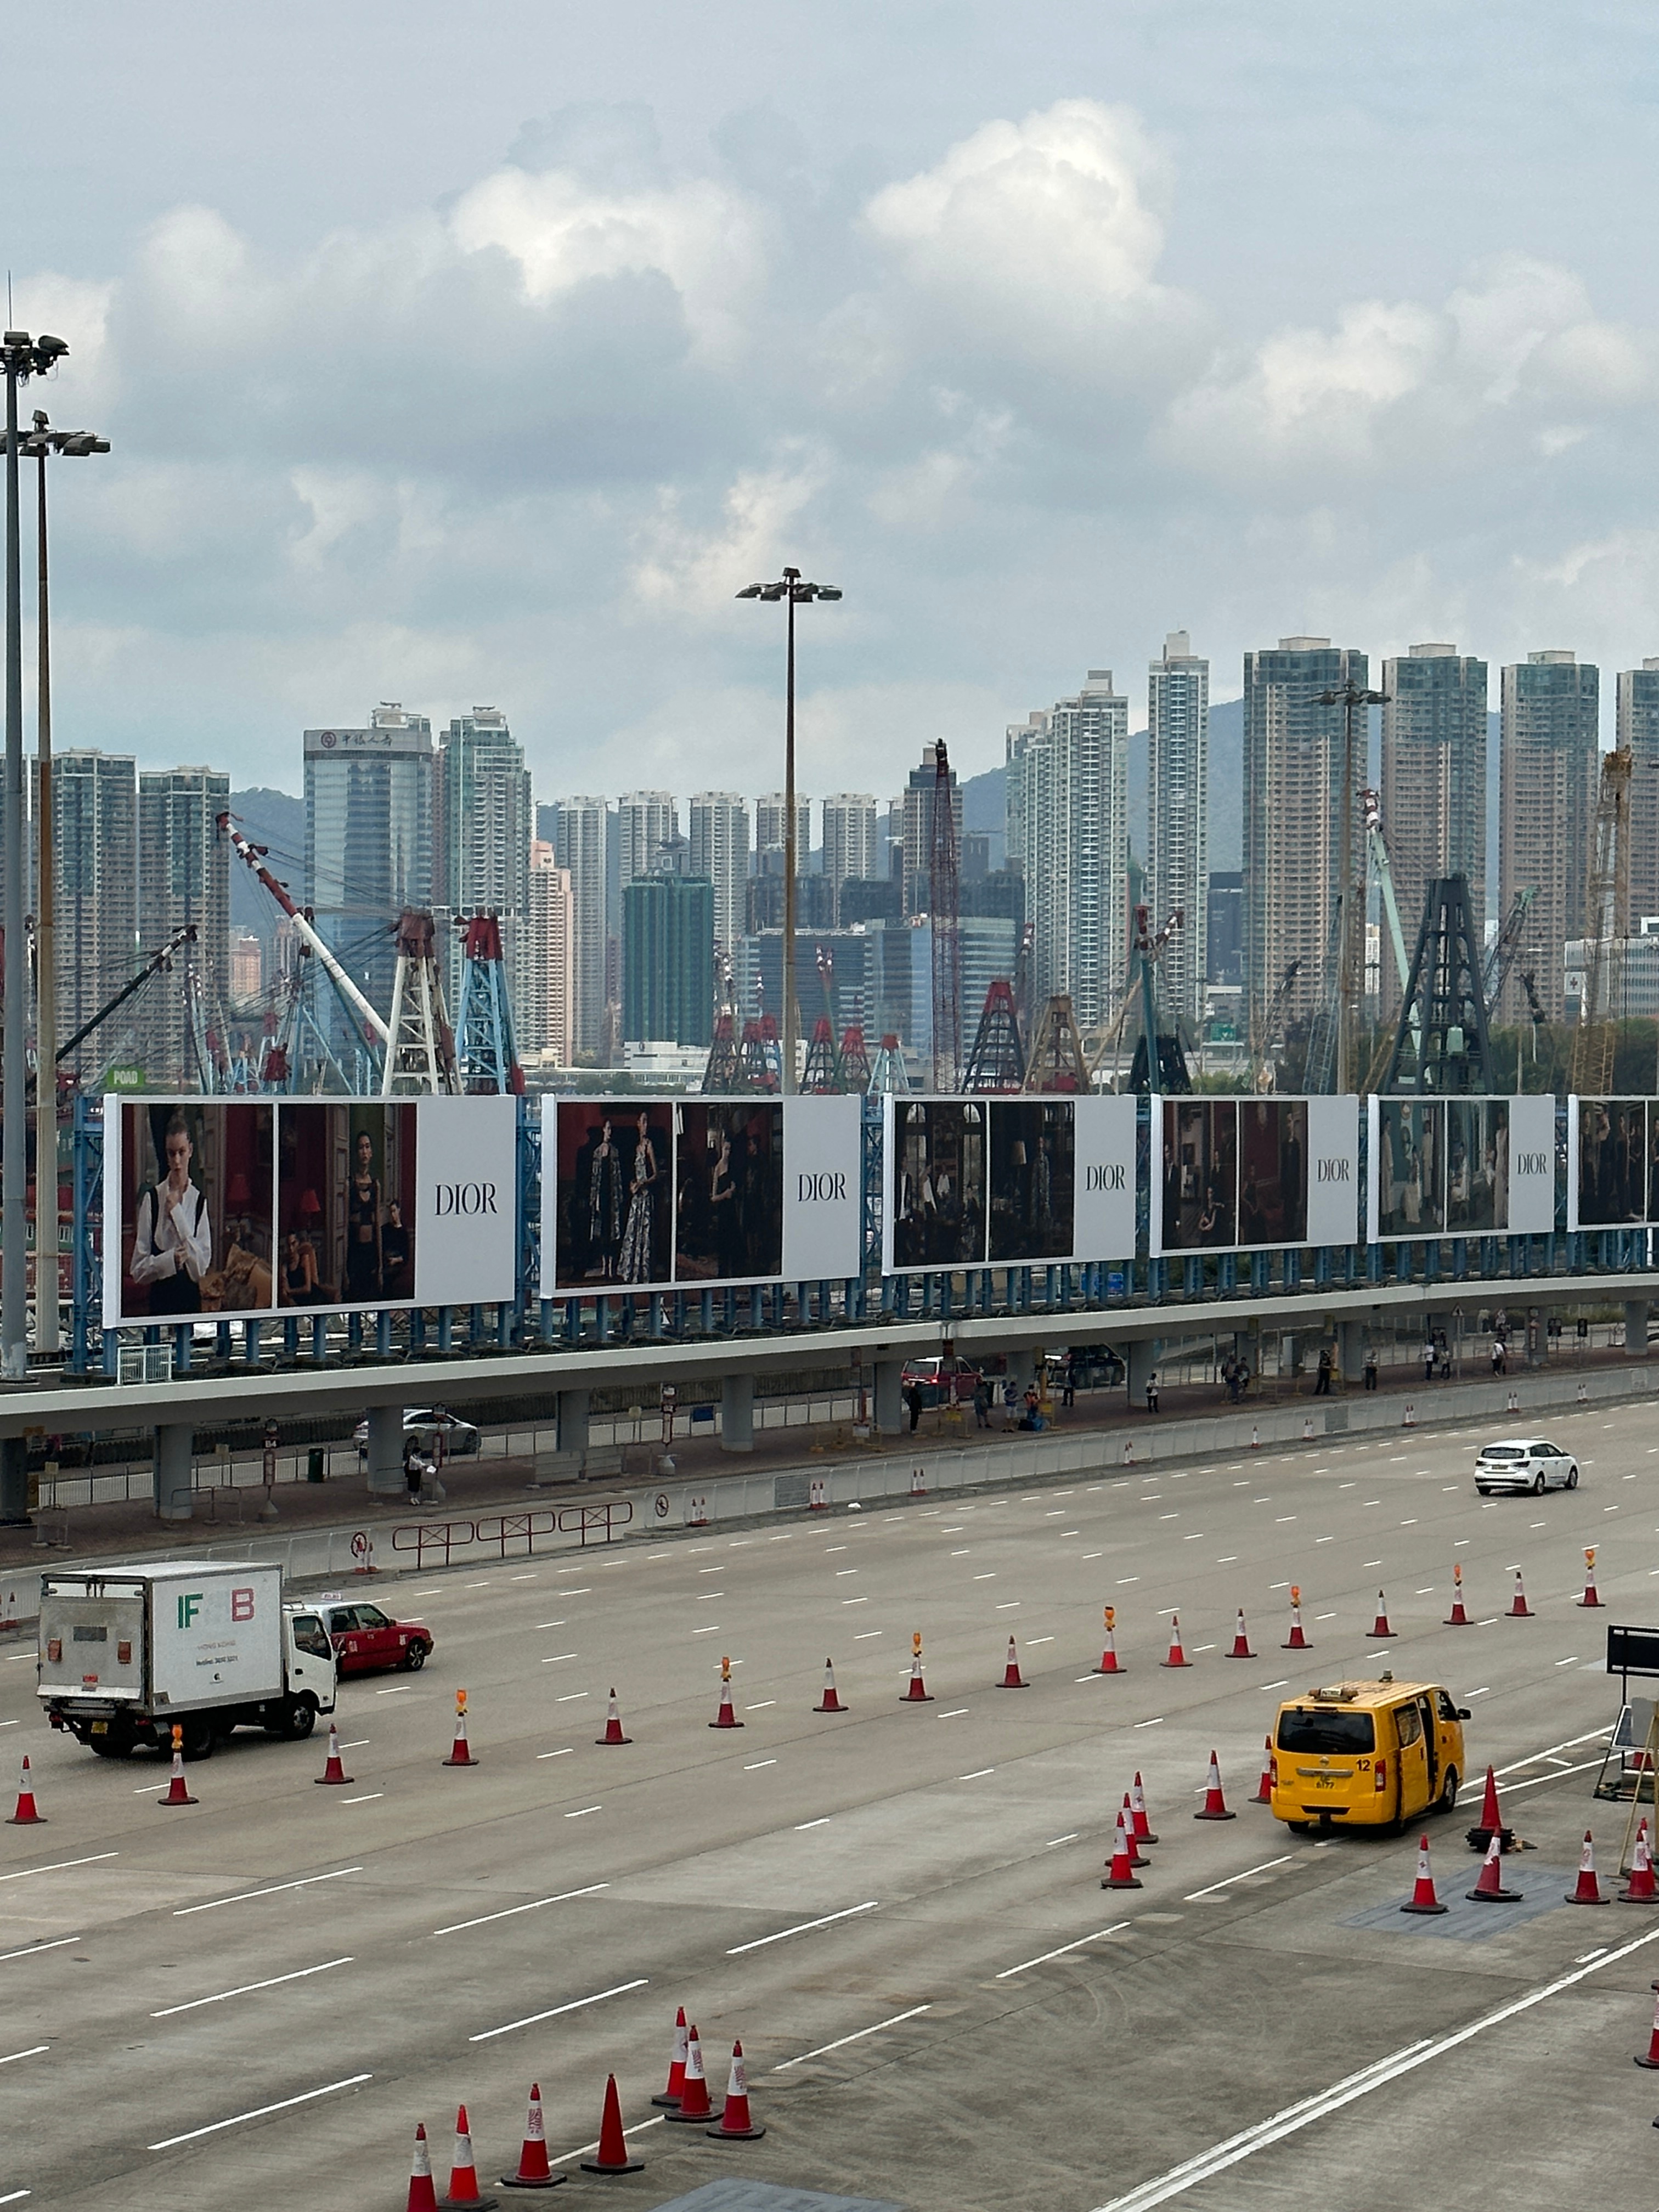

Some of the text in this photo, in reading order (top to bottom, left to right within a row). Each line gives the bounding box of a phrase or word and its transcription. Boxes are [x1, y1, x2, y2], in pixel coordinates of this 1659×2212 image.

[114, 1070, 138, 1084] POAD
[1317, 1158, 1350, 1182] DIOR
[1517, 1153, 1547, 1175] DIOR
[798, 1172, 847, 1202] DIOR
[1086, 1164, 1125, 1191] DIOR
[435, 1182, 498, 1216] DIOR
[232, 1588, 255, 1622] B
[1356, 1759, 1371, 1771] 12
